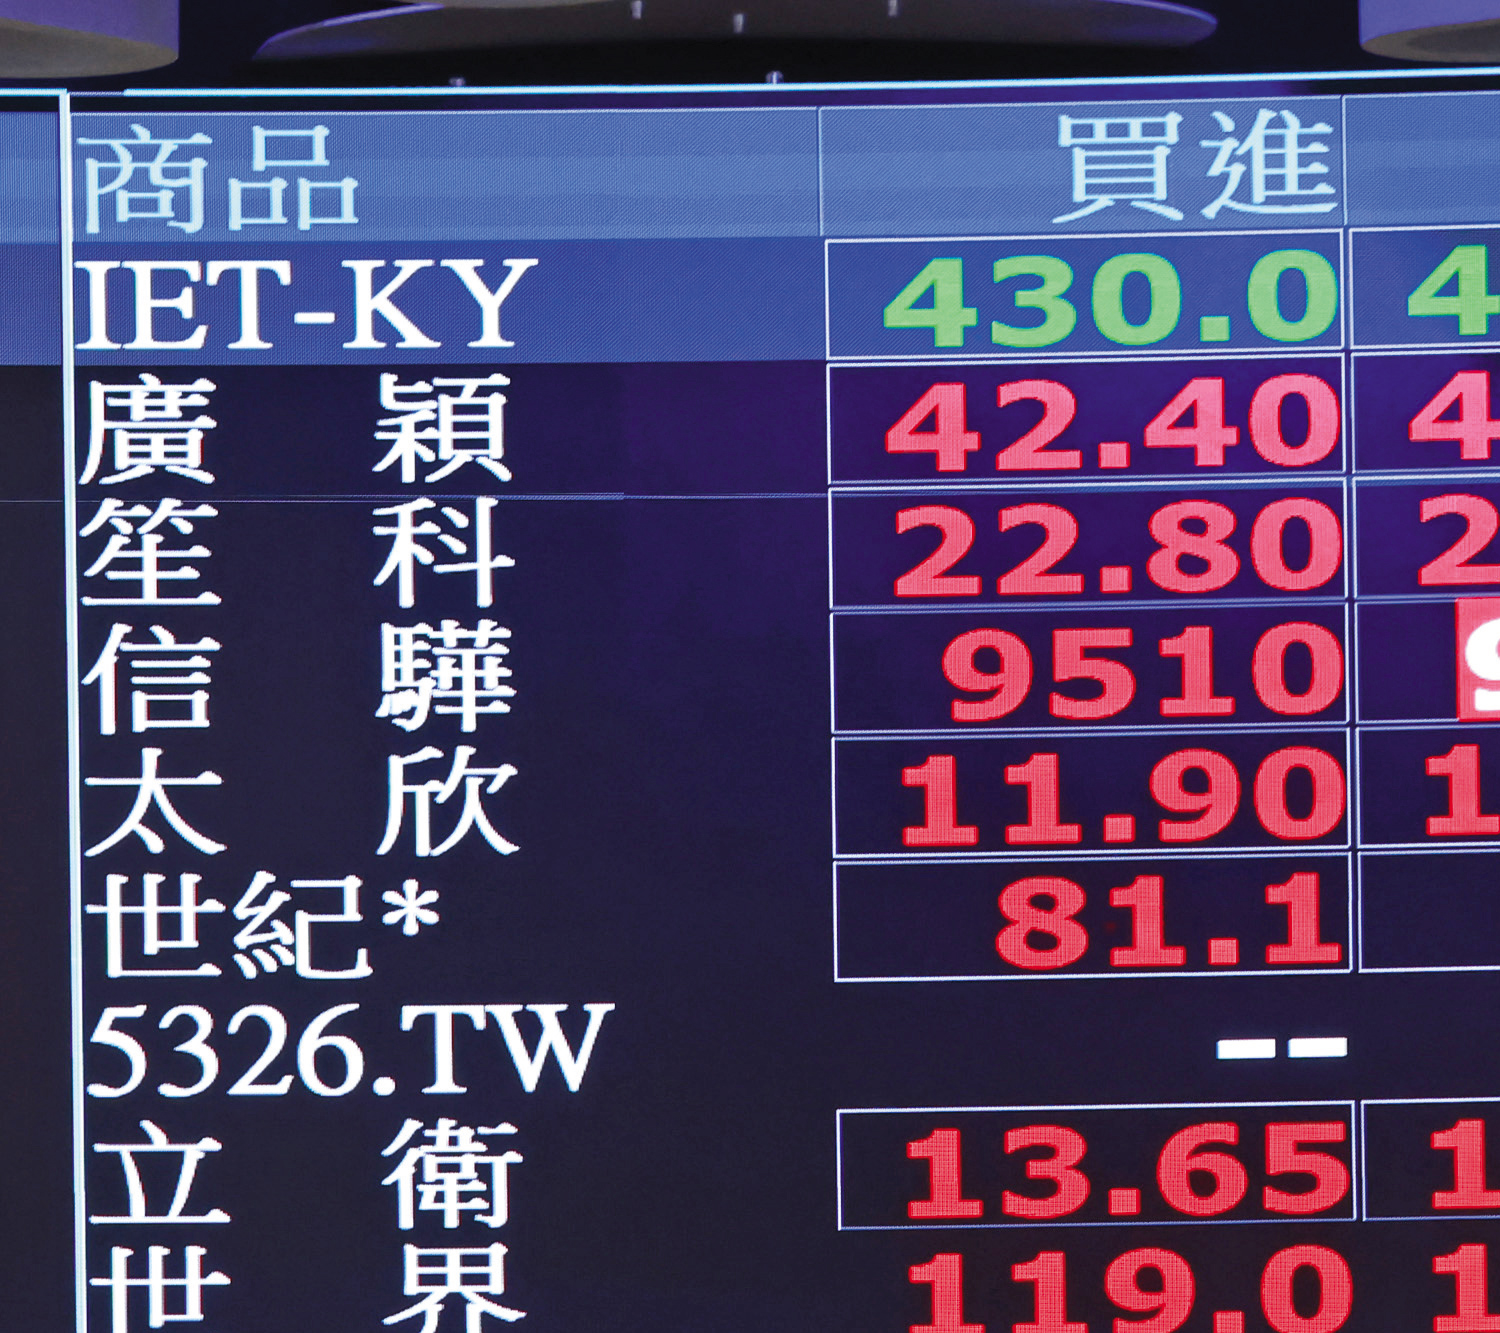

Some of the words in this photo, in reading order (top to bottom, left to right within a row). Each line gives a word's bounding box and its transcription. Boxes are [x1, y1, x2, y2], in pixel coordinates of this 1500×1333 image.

[79, 125, 358, 233] 商品
[1053, 109, 1337, 223] 買進
[71, 254, 538, 355] IET-KY
[883, 249, 1338, 348] 430.0
[942, 622, 1344, 722] 9510
[996, 872, 1342, 970] 81.1
[87, 1003, 615, 1097] 5326.TW
